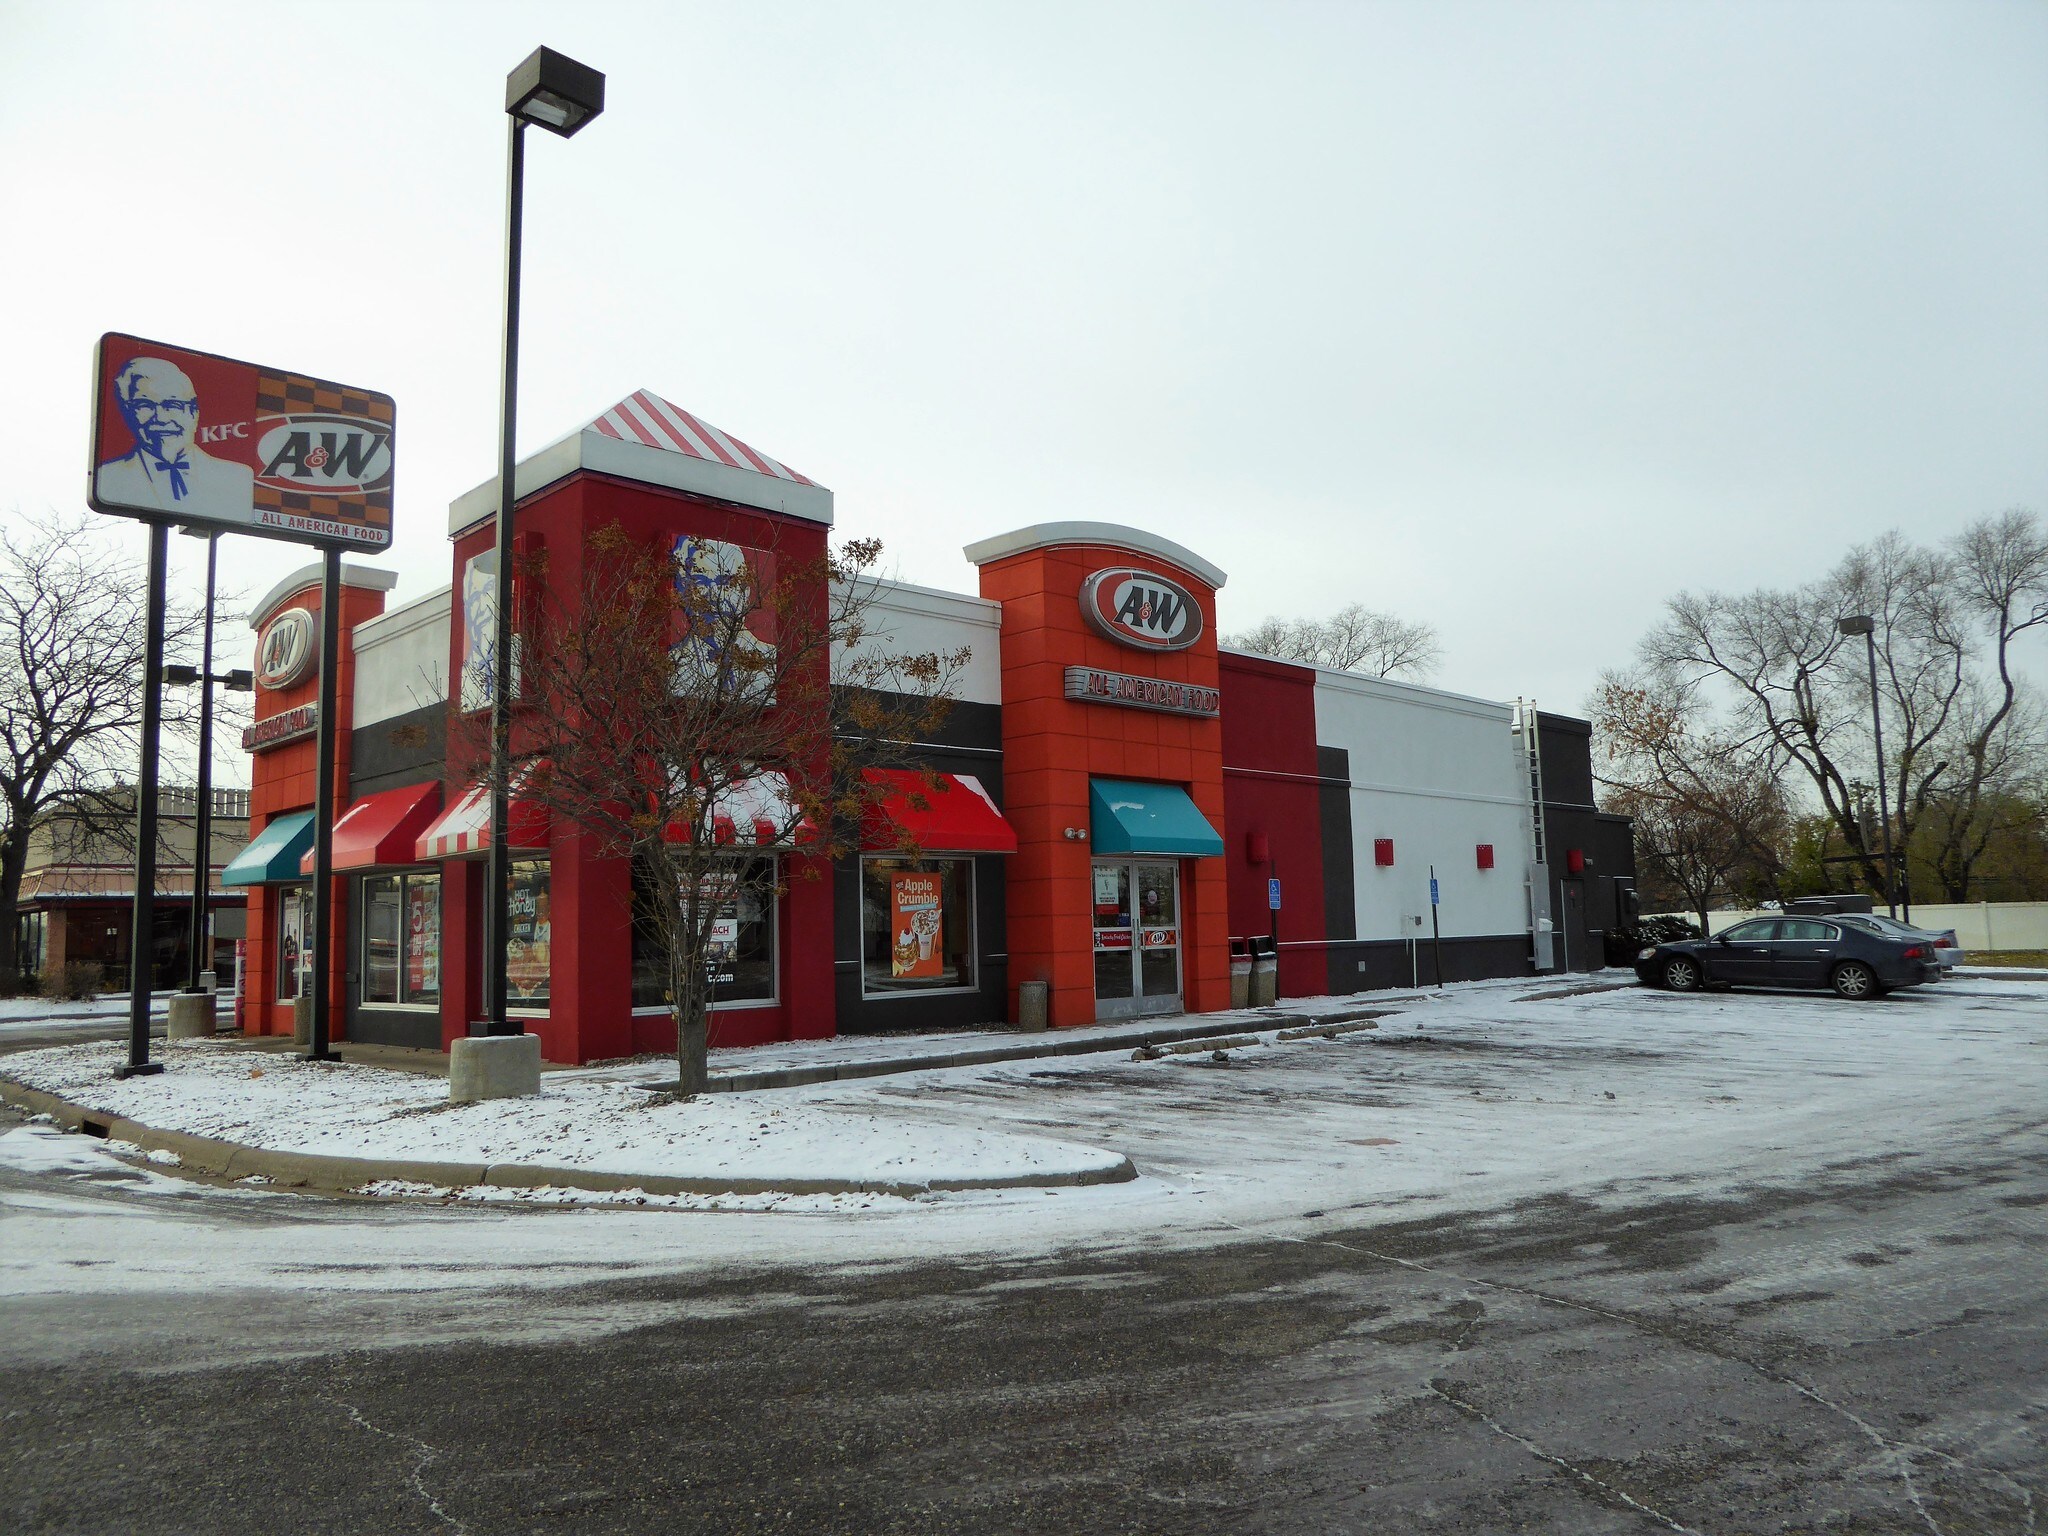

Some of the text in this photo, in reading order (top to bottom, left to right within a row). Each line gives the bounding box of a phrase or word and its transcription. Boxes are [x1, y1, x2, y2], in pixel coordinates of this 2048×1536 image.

[201, 421, 249, 444] KFC
[258, 431, 390, 479] A&W
[261, 512, 383, 542] ALL AMERICAN FOOD
[1113, 585, 1187, 635] A&W
[1086, 672, 1220, 712] ALL AMERICAN FOOD
[515, 889, 530, 900] HOT
[905, 879, 933, 894] Apple
[509, 897, 536, 917] Honey
[897, 892, 939, 905] Crumble
